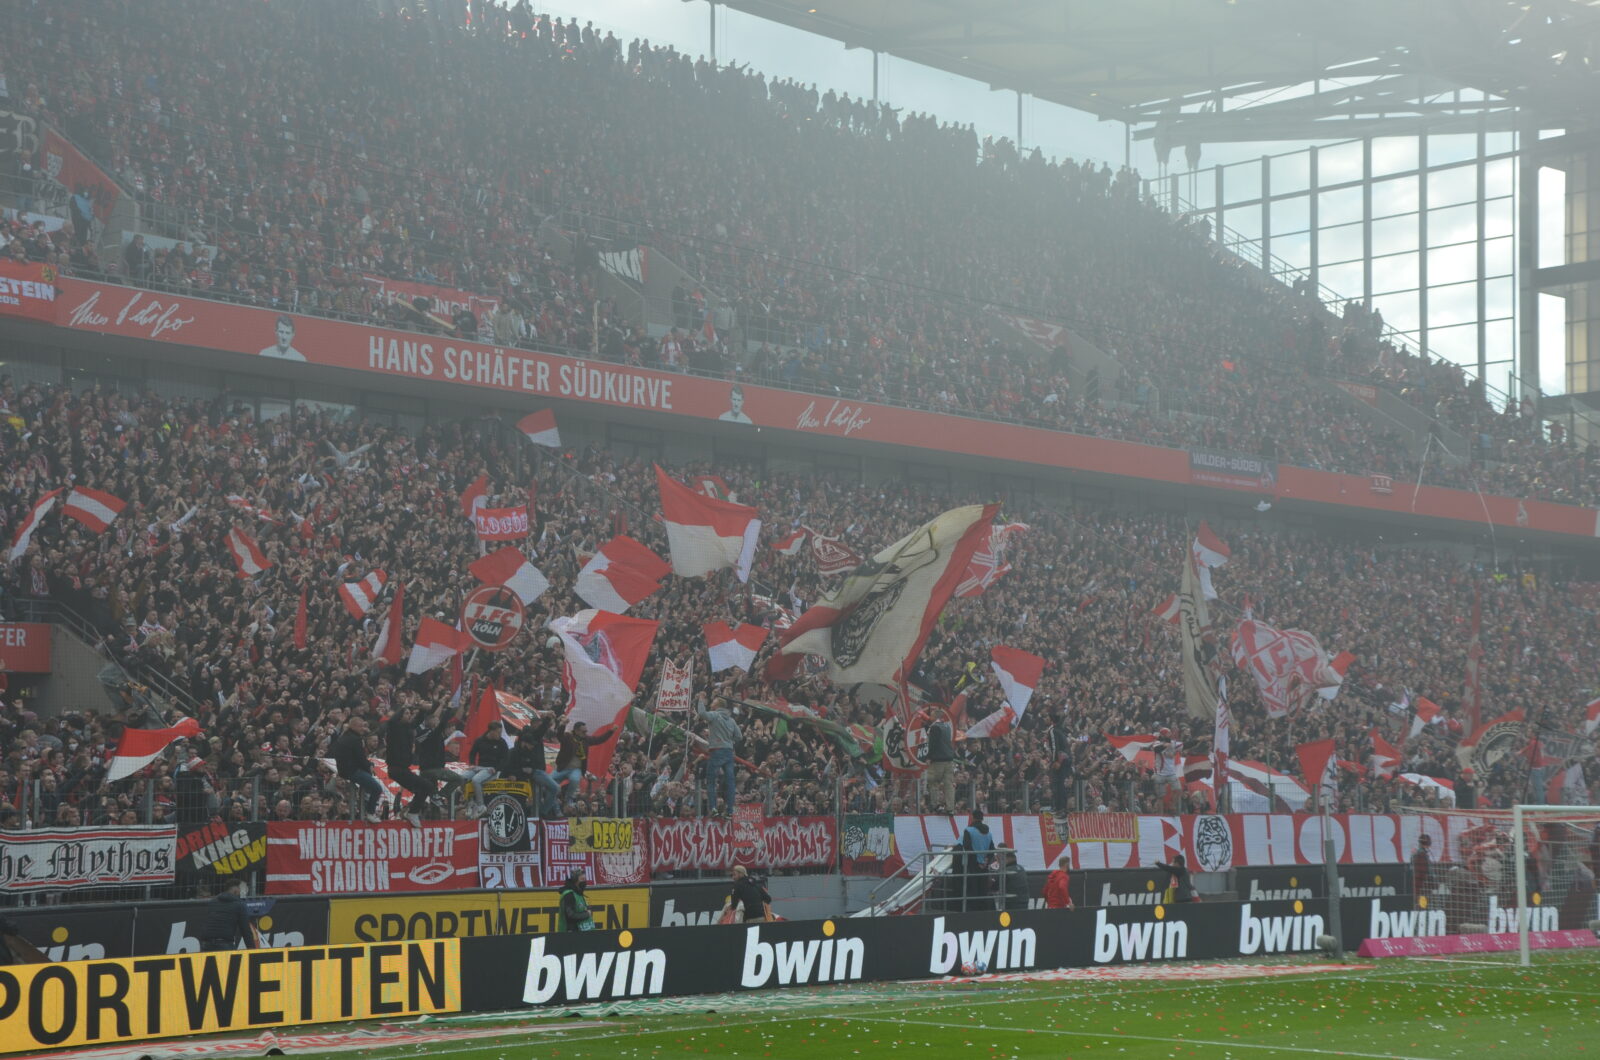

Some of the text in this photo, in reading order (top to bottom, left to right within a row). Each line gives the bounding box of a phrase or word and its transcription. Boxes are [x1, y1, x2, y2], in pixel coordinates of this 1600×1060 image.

[369, 335, 674, 411] HANS SCHÄFER SÜDKURVE
[1192, 452, 1226, 469] WILDER
[472, 620, 502, 637] KÖLN
[176, 822, 229, 861] DRIN
[298, 823, 455, 861] MÜNGERSDORFER
[592, 821, 617, 849] DES
[618, 822, 632, 849] 99
[1069, 813, 1136, 840] STADIONVERBOT
[47, 841, 170, 884] Mythos
[192, 829, 250, 871] KING
[213, 835, 266, 875] NOW
[311, 860, 390, 892] STADION
[1093, 904, 1189, 963] bwin
[1239, 900, 1325, 955] bwin
[1370, 895, 1447, 938] bwin
[1489, 891, 1560, 936] bwin
[740, 919, 866, 988] bwin
[929, 911, 1037, 975] bwin
[522, 930, 667, 1004] bwin
